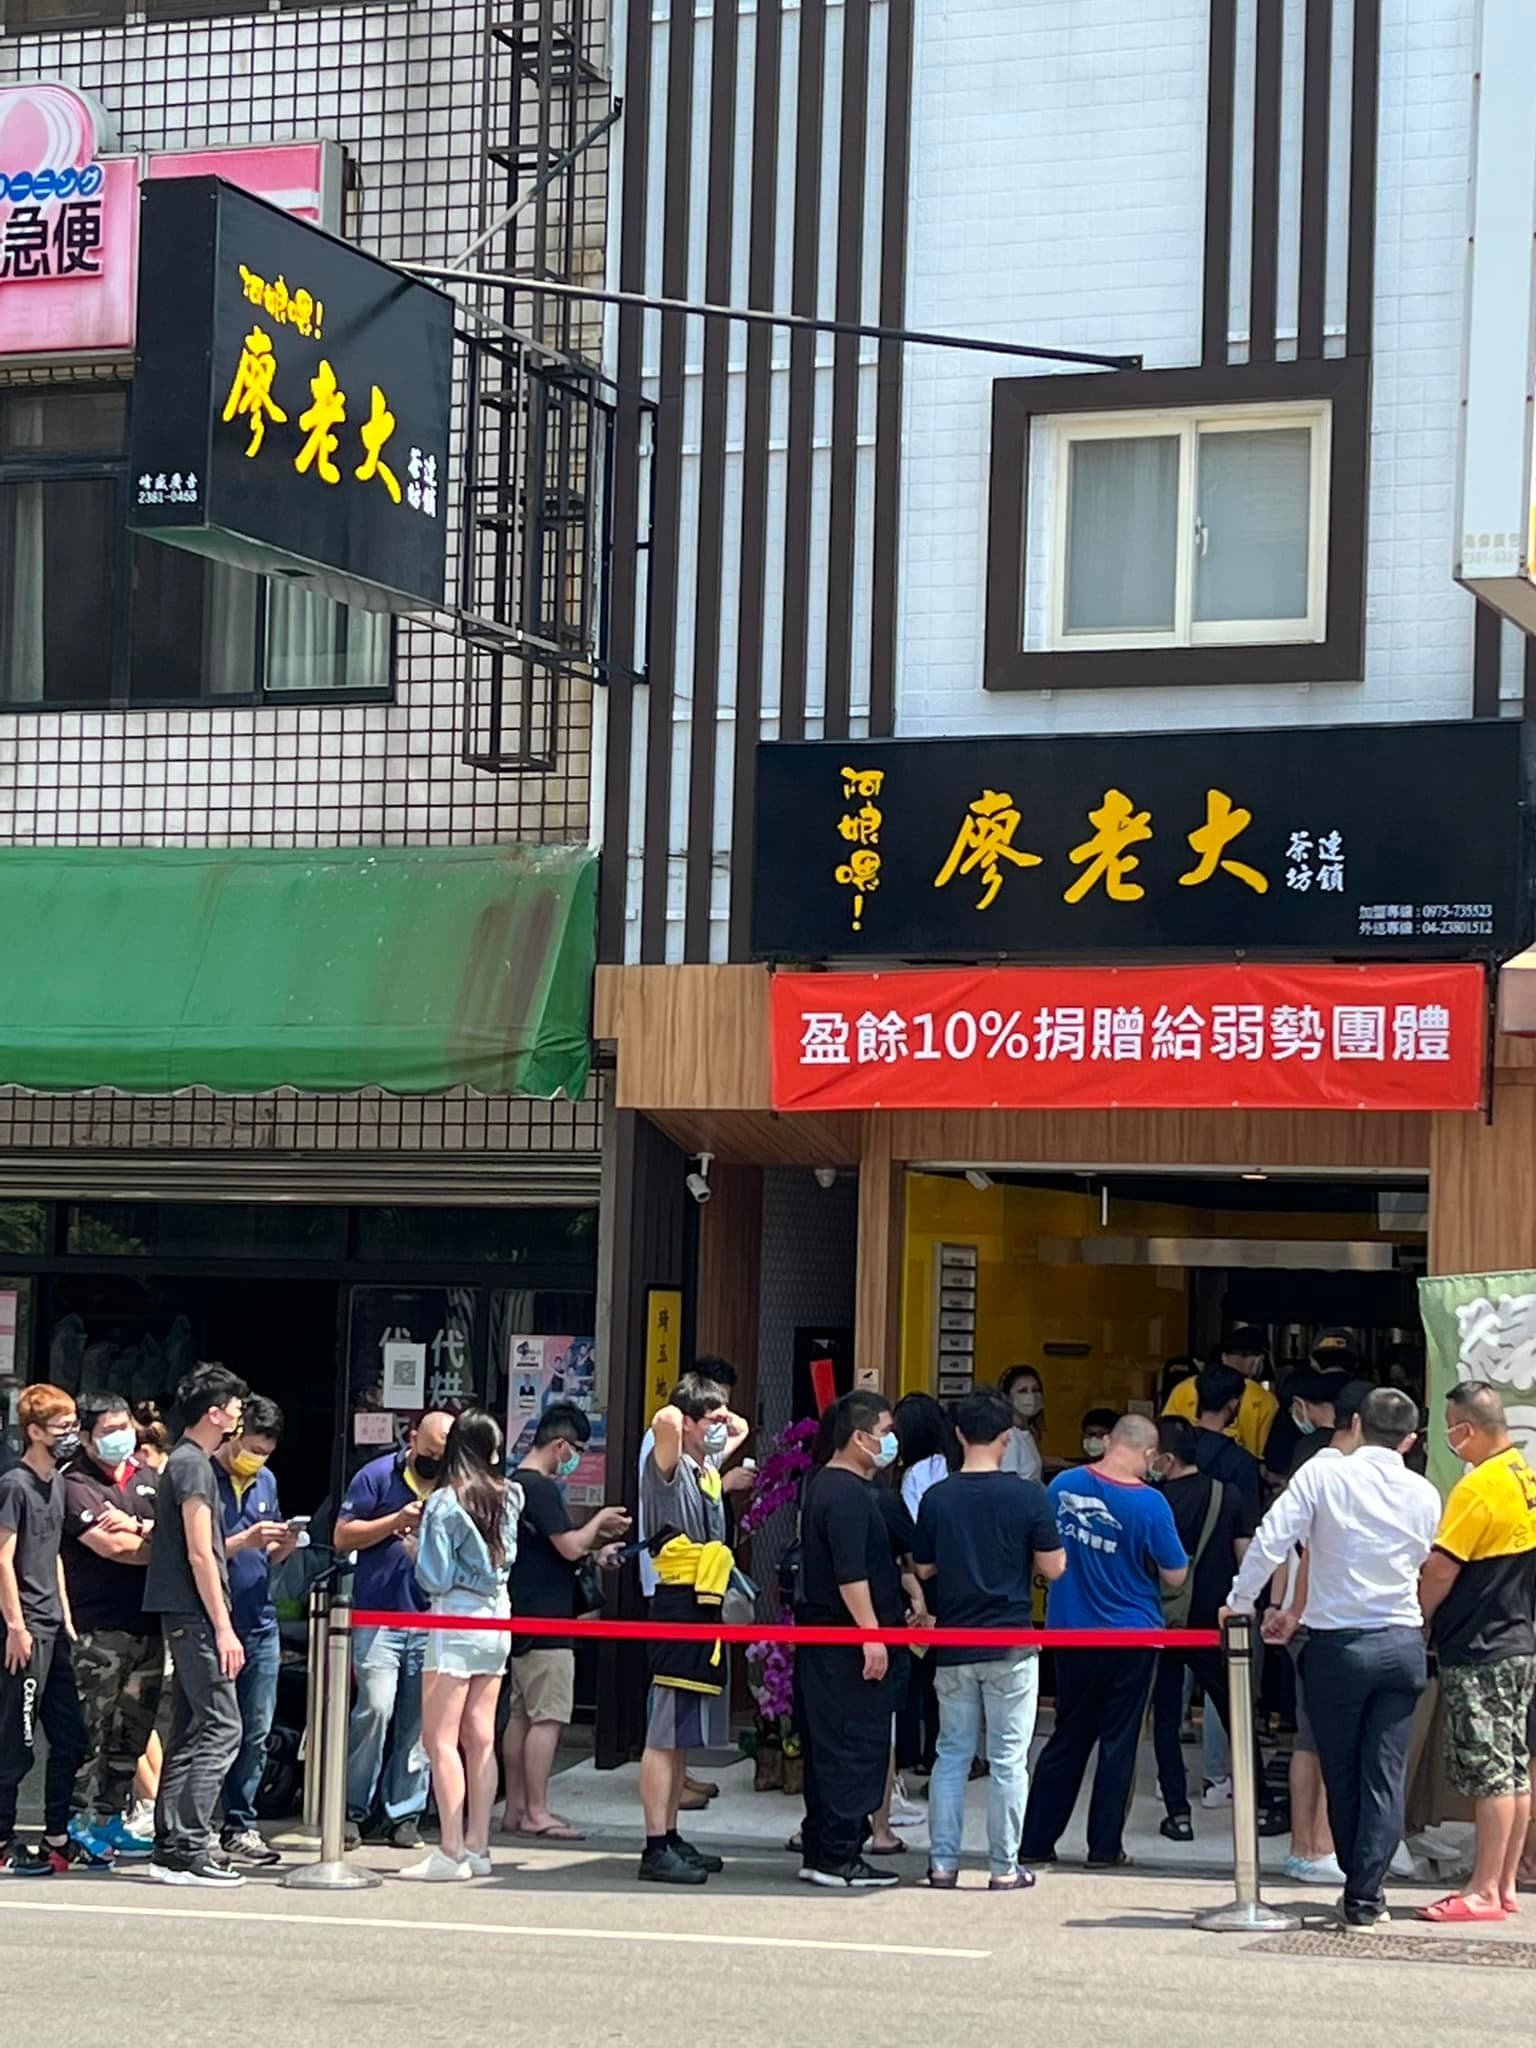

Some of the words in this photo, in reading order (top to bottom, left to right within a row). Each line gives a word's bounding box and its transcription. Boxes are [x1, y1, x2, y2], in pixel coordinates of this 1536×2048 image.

[222, 325, 403, 504] 廖老大
[933, 789, 1269, 910] 廖老大
[799, 1004, 1450, 1064] 盈餘10%捐贈給弱勢團體
